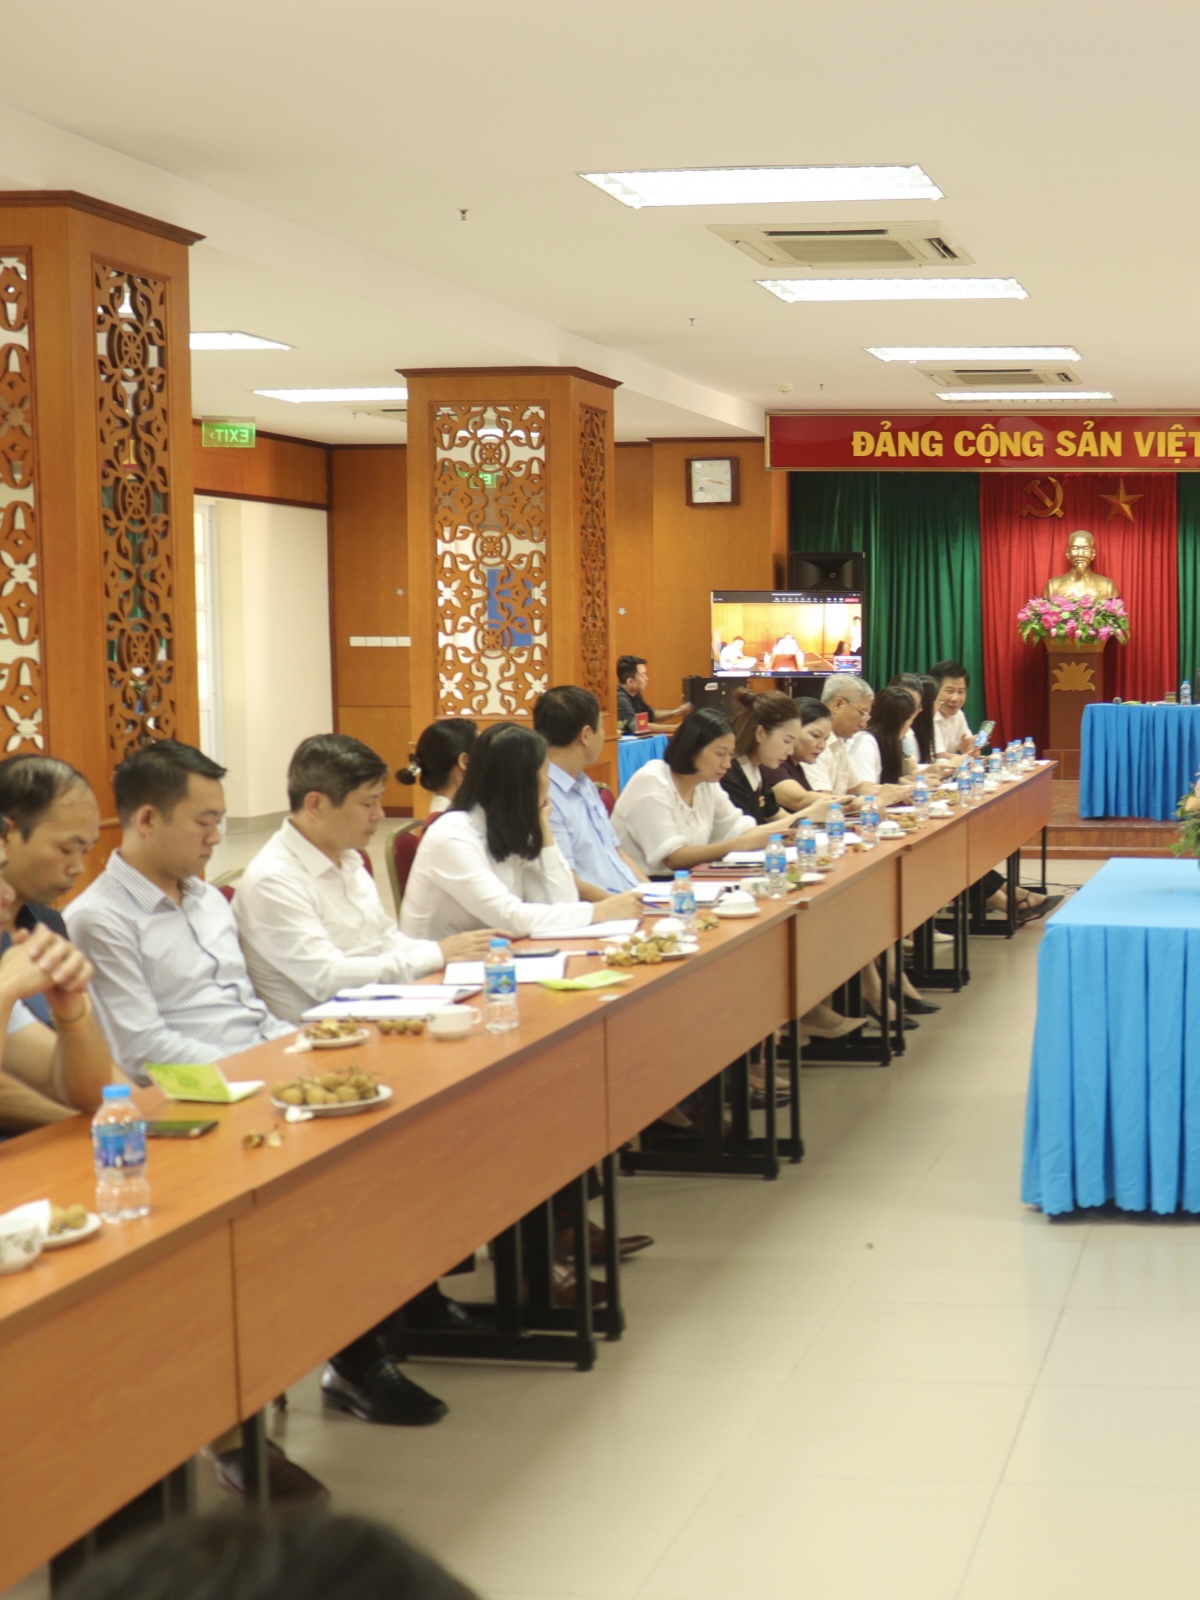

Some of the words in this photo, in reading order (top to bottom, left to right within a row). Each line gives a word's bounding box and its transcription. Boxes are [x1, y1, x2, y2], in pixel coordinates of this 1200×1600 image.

[851, 420, 944, 457] ĐẢNG
[953, 423, 1044, 464] CỘNG
[1055, 420, 1122, 457] SẢN
